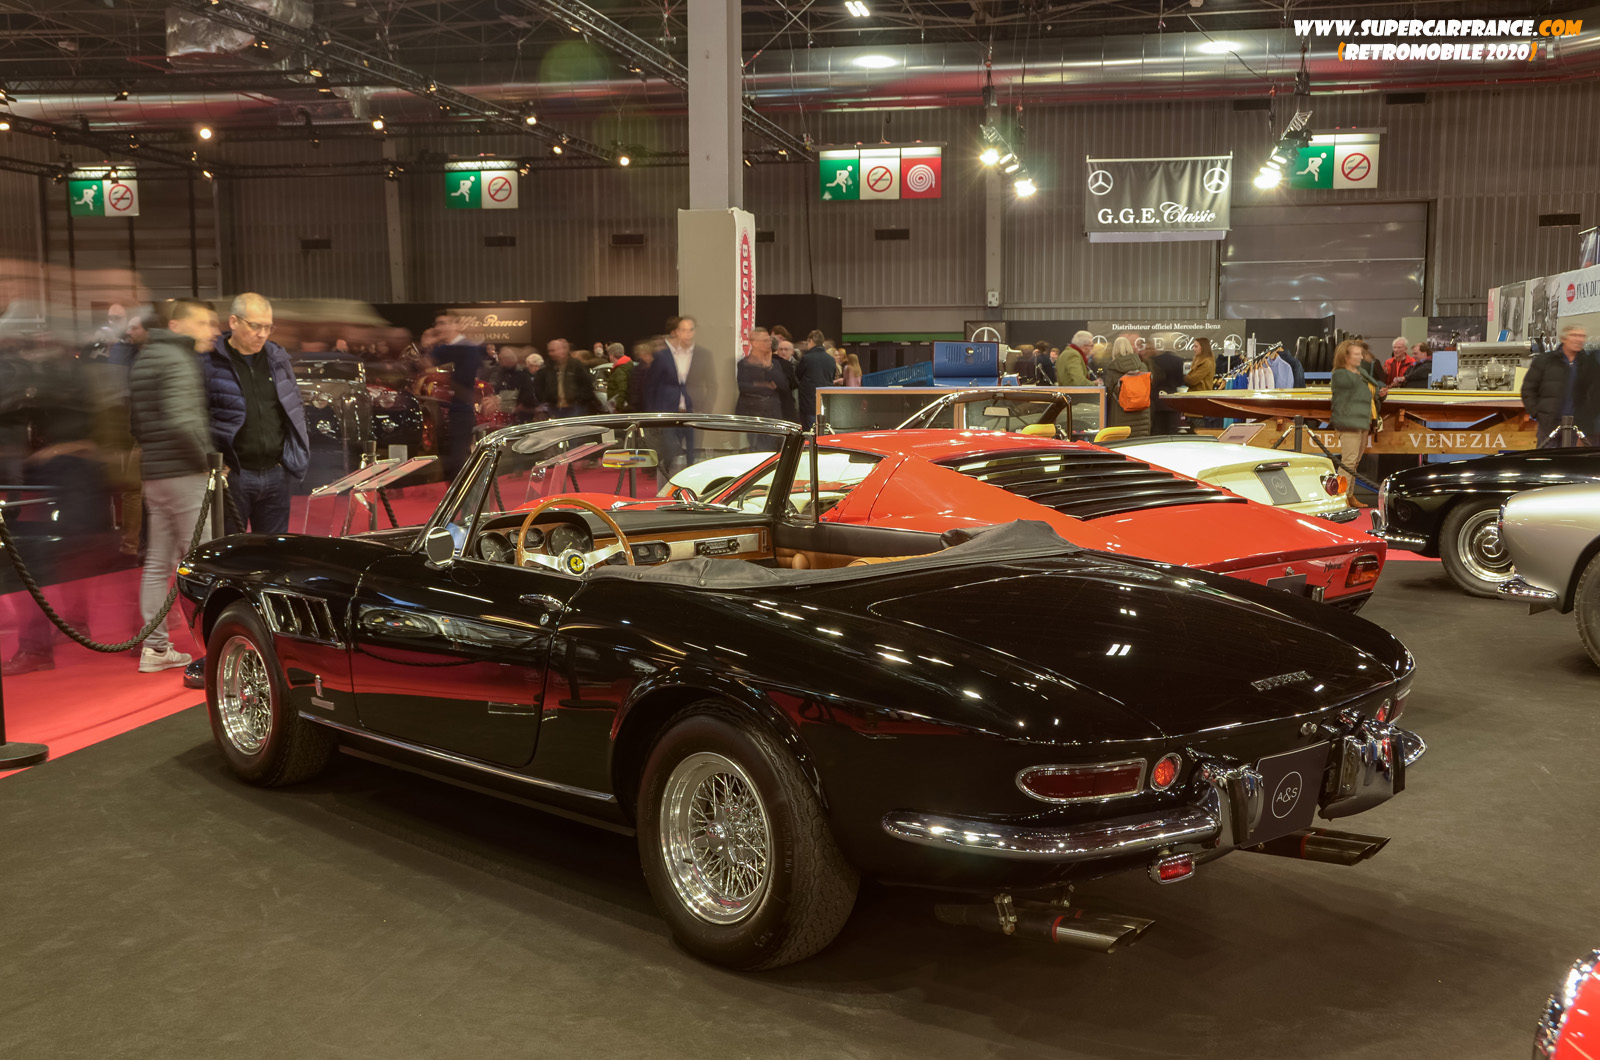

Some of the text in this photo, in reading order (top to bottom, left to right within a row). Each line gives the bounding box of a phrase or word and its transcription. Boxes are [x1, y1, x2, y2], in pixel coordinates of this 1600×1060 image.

[1097, 201, 1216, 224] G.G.E. Classic
[483, 314, 528, 328] Romeo
[1112, 322, 1221, 331] Distributeur officiel Mercedes-Benz
[1408, 433, 1507, 448] VENEZIA
[1276, 787, 1298, 803] A&S
